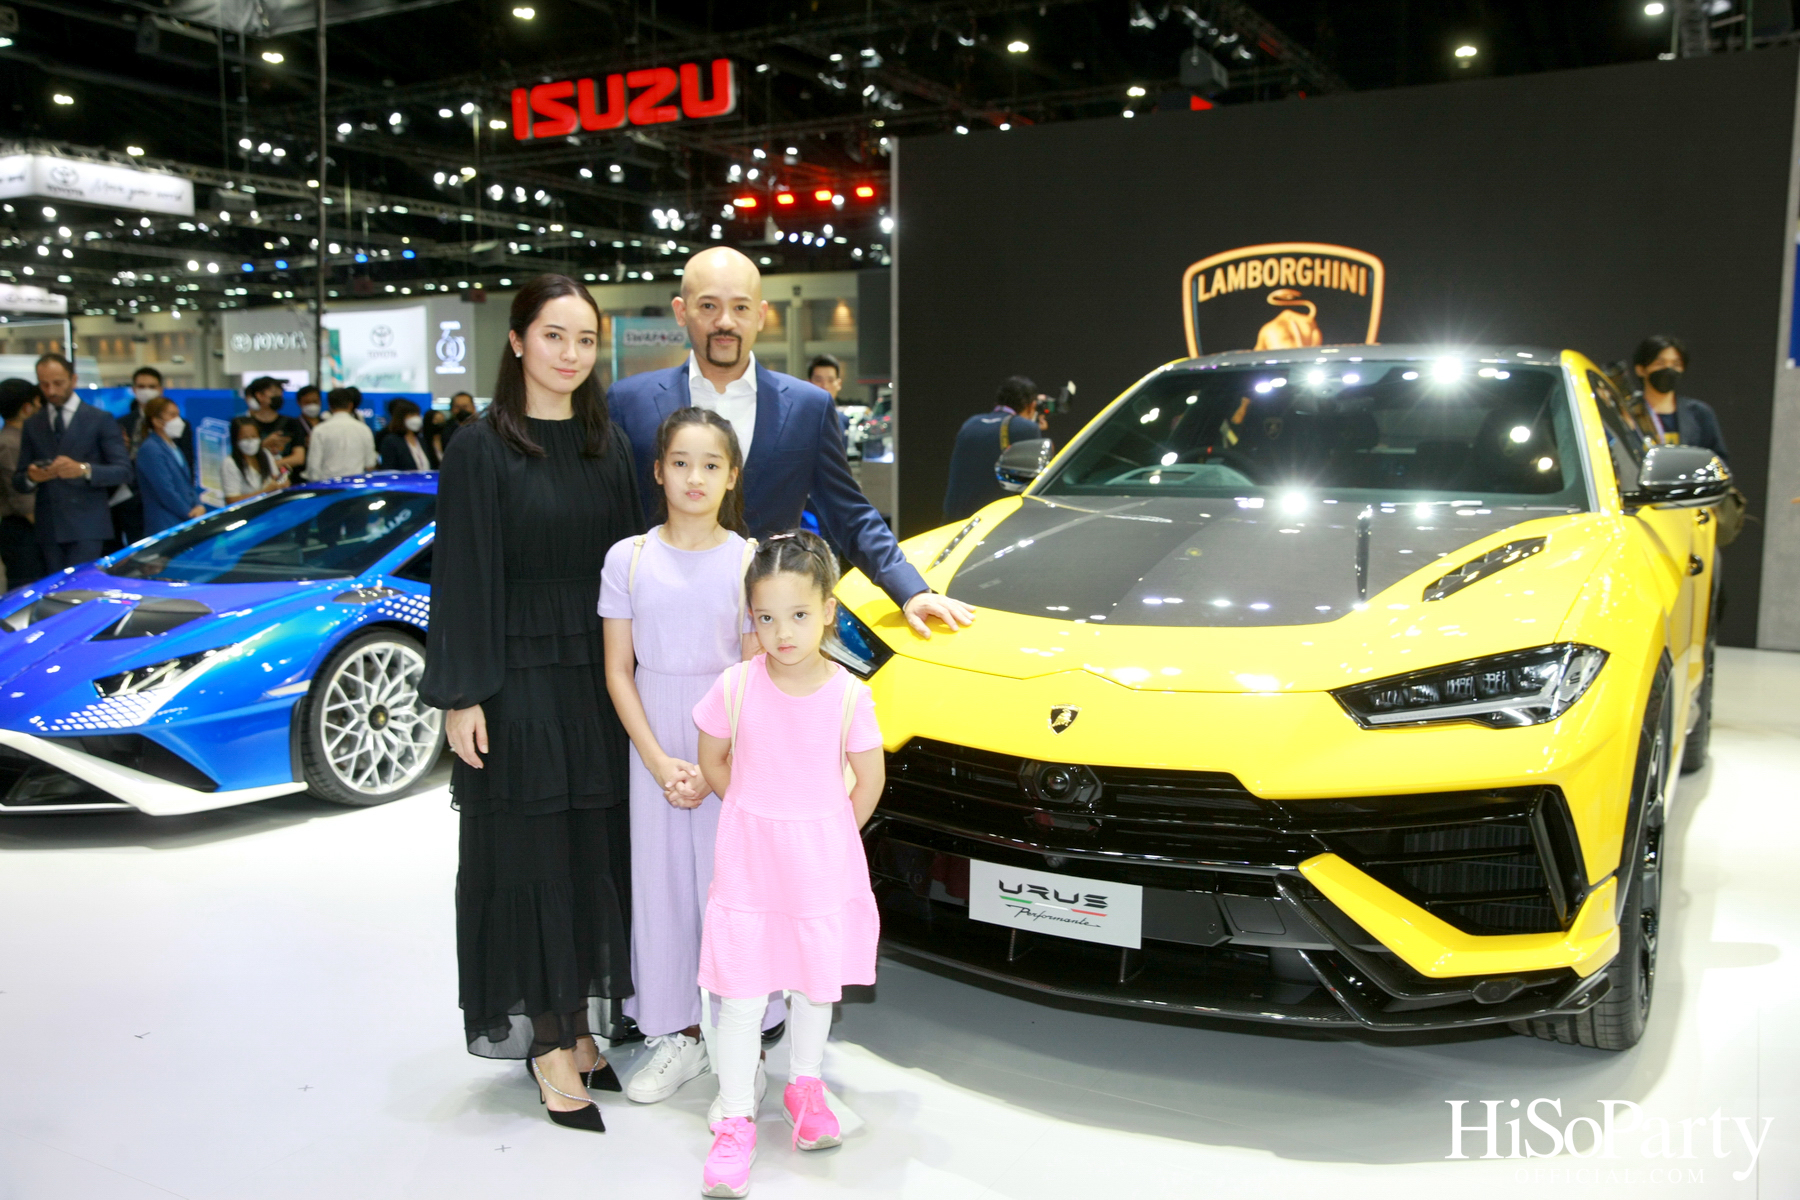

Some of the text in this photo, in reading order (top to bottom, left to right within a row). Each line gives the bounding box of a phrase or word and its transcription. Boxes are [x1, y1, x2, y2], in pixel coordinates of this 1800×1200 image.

[511, 58, 736, 140] ISUZU
[1197, 257, 1367, 303] LAMBORGHINI
[998, 879, 1109, 910] URUS
[1005, 902, 1102, 929] Performante
